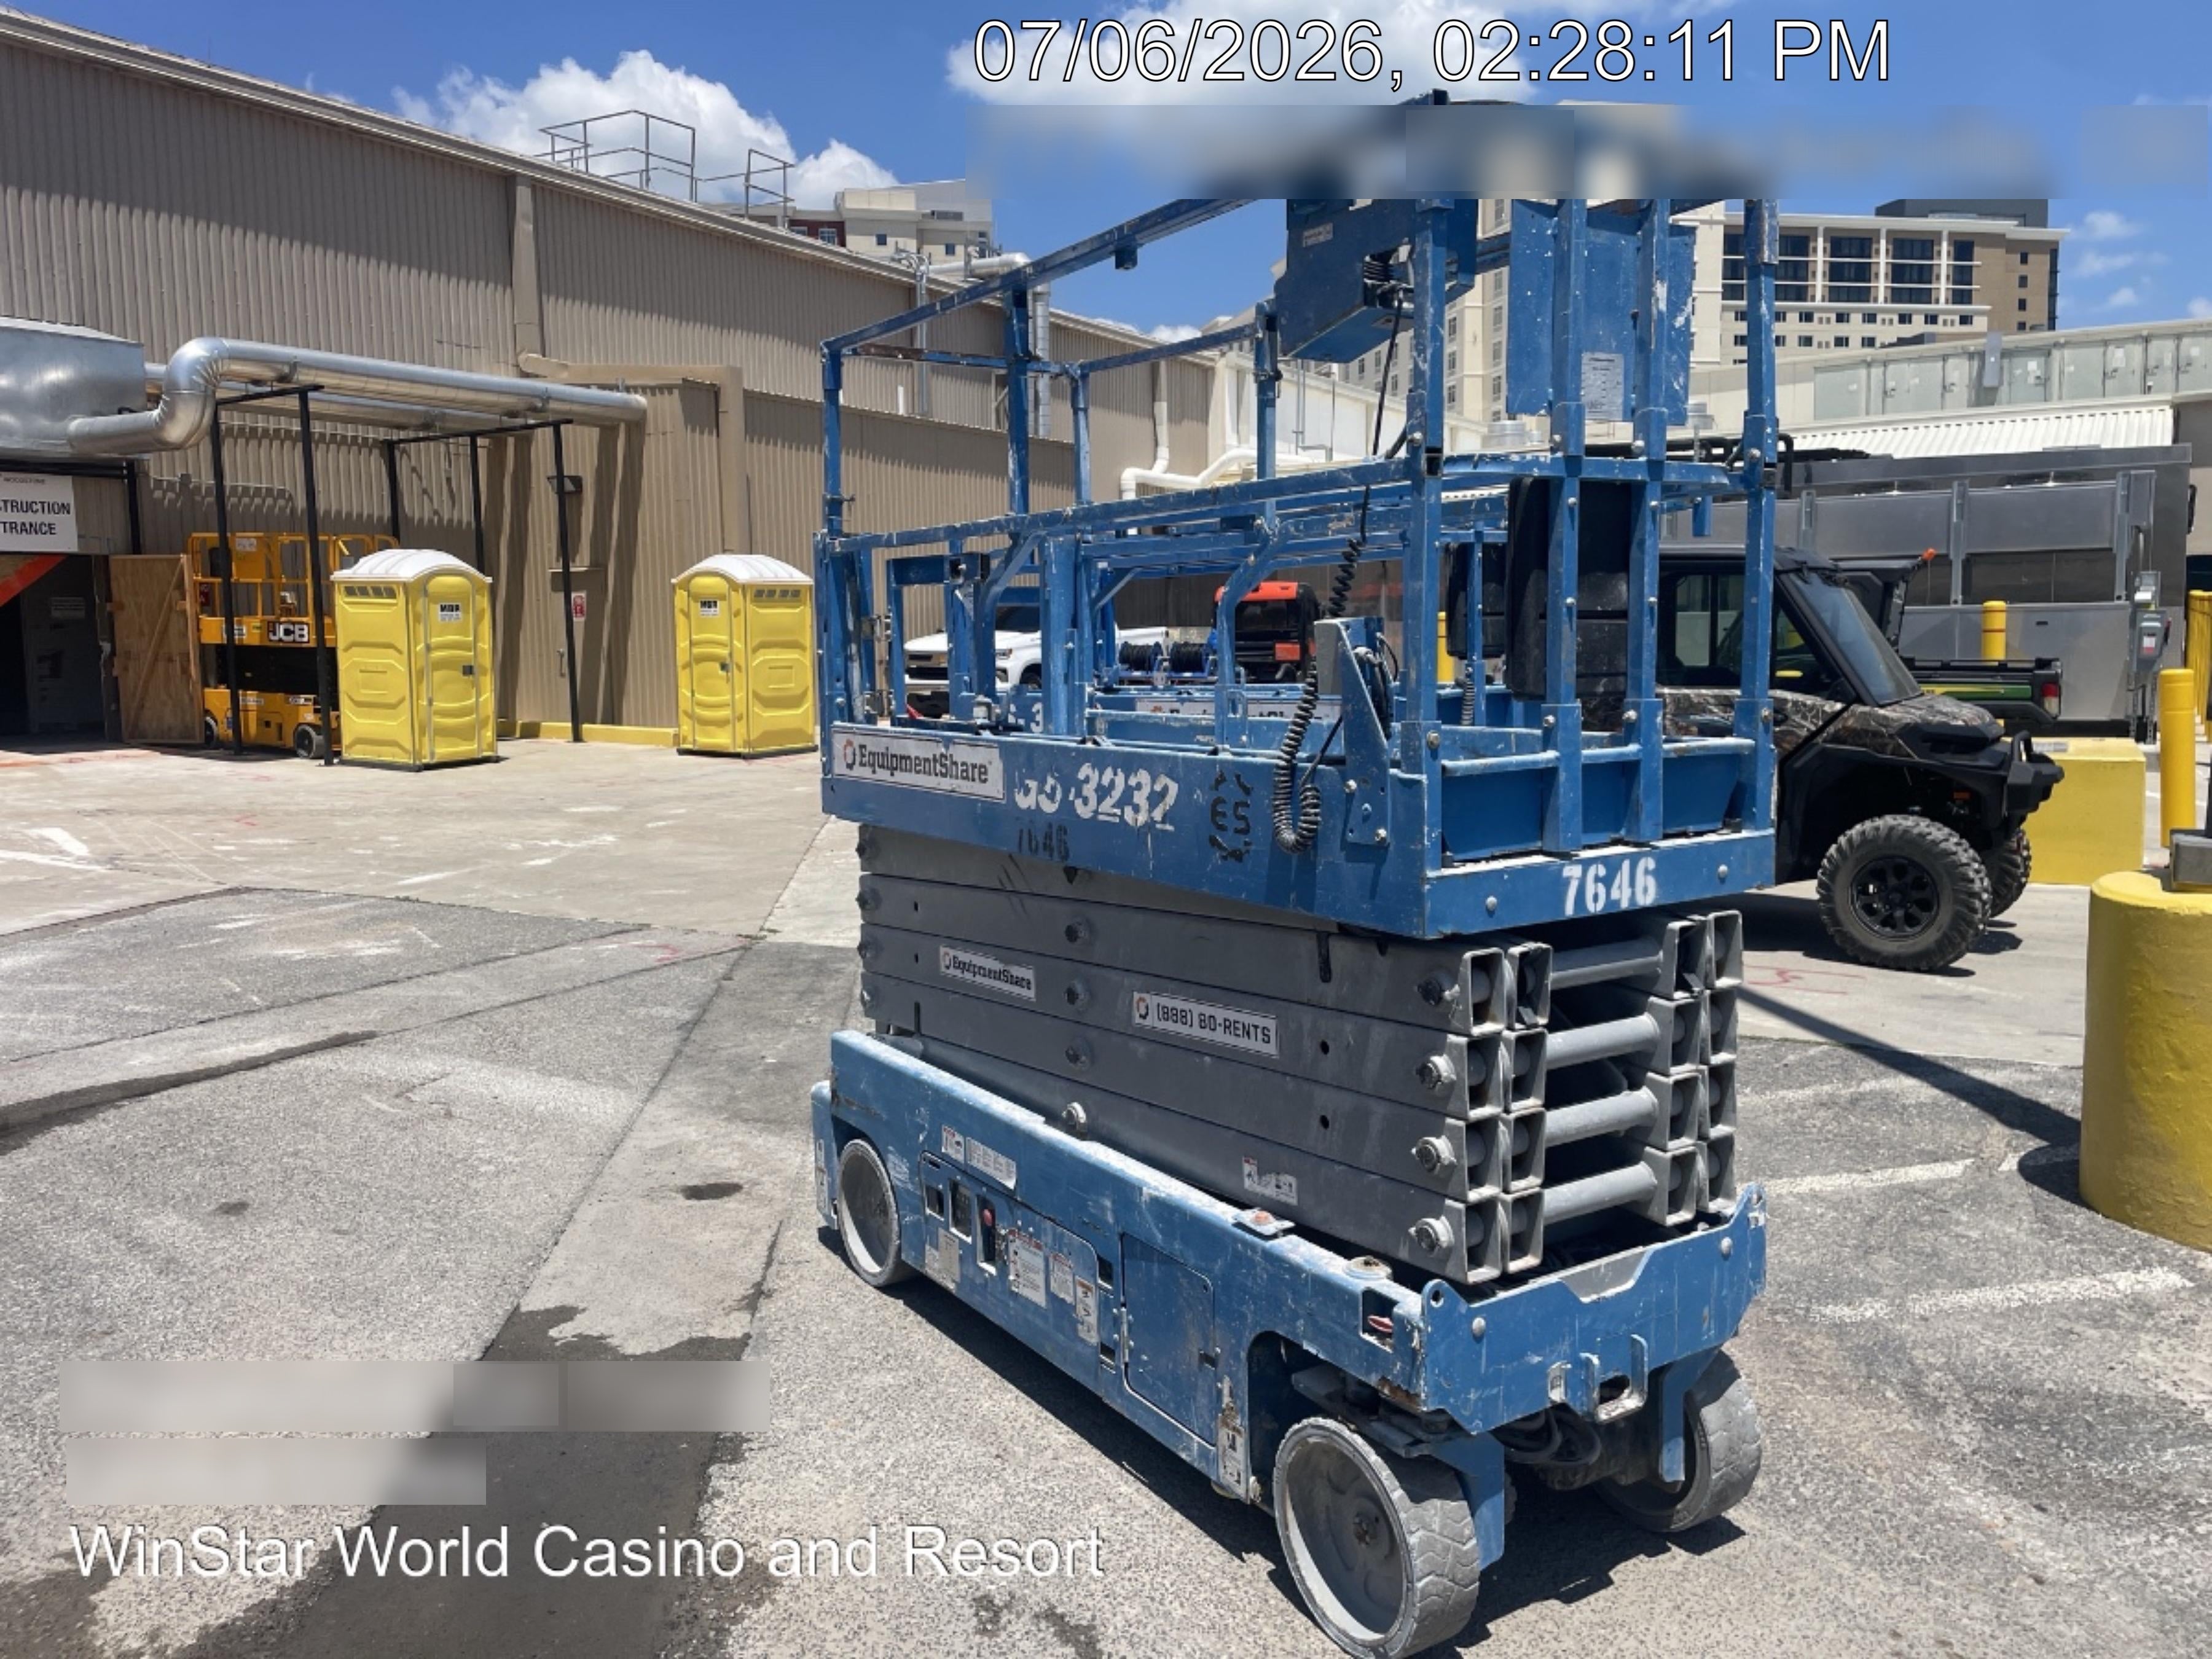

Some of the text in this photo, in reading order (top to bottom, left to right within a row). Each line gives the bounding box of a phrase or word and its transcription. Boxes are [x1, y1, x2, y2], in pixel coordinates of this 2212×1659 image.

[0, 499, 71, 515] TRUCTION
[269, 622, 309, 642] JCB
[858, 743, 989, 784] EquipmentShare
[1563, 857, 1657, 917] 7646
[1156, 1002, 1271, 1044] (888) 80-RENTS
